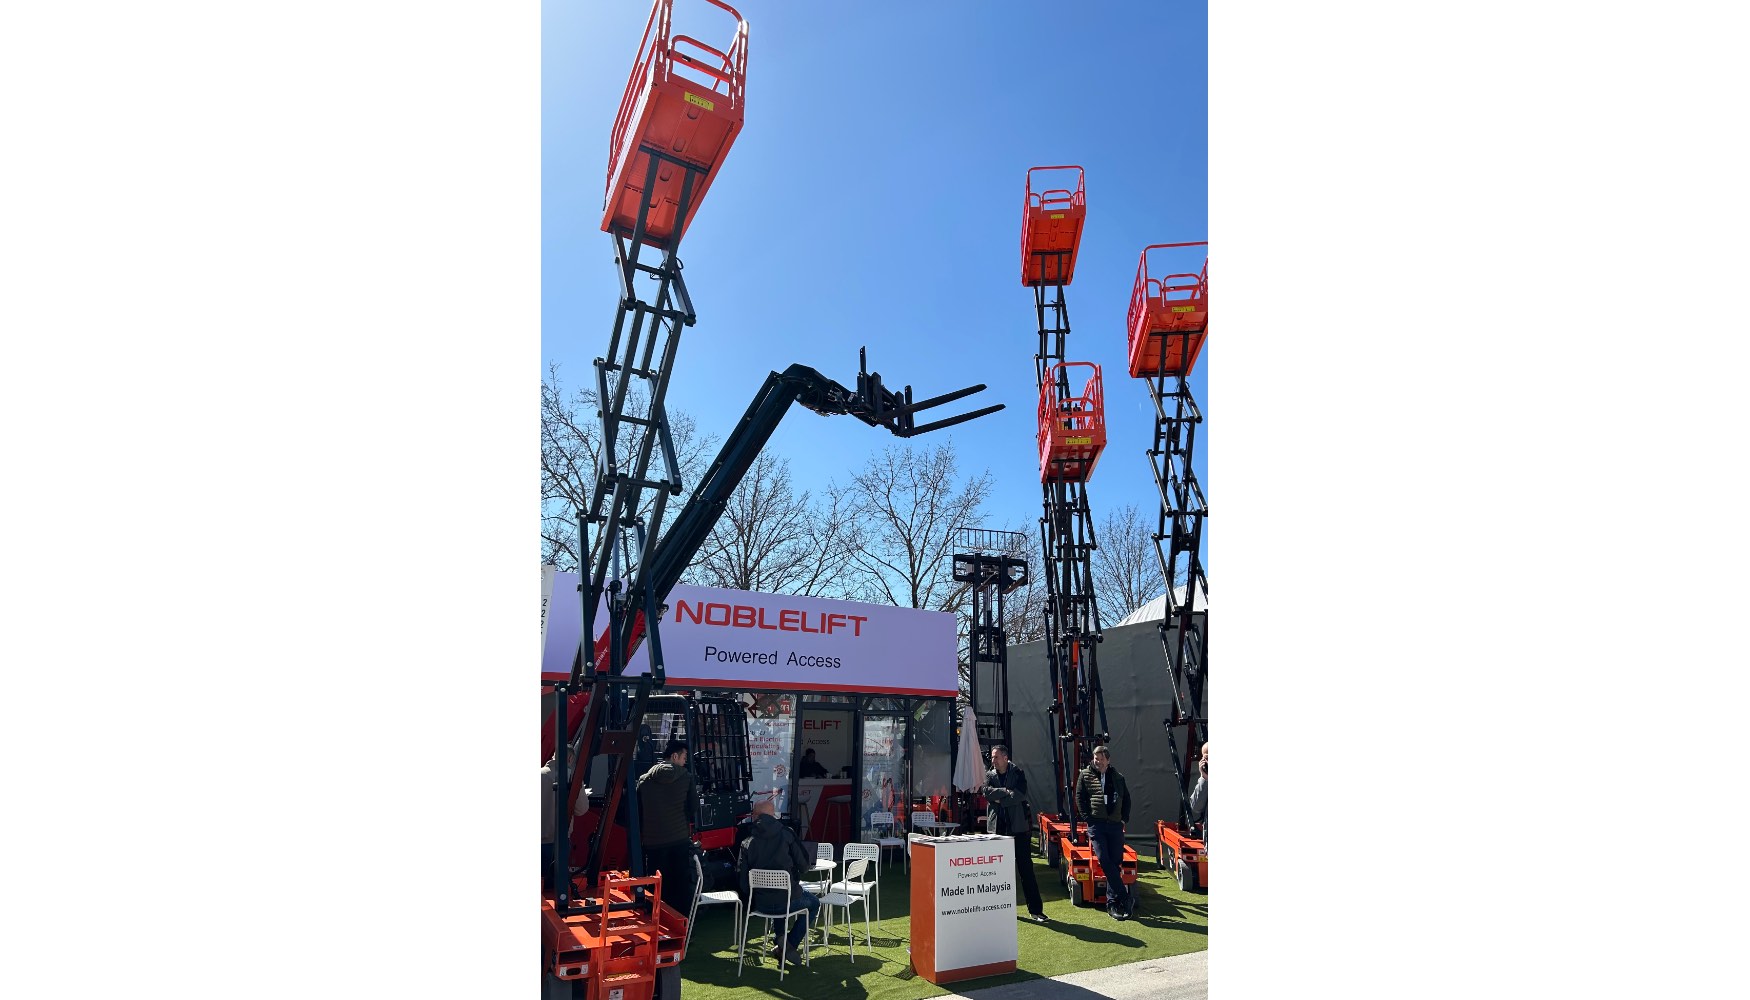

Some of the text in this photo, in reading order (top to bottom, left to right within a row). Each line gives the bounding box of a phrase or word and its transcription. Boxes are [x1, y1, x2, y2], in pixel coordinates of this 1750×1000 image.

[675, 599, 868, 637] NOBLELIFT
[704, 646, 841, 668] Powered Access
[803, 719, 842, 730] ELIFT
[949, 854, 1004, 867] NOBLELIFT
[957, 871, 979, 879] Powered
[941, 881, 1012, 897] Made In Malaysia
[941, 902, 1012, 916] www.noblelift-access.com
